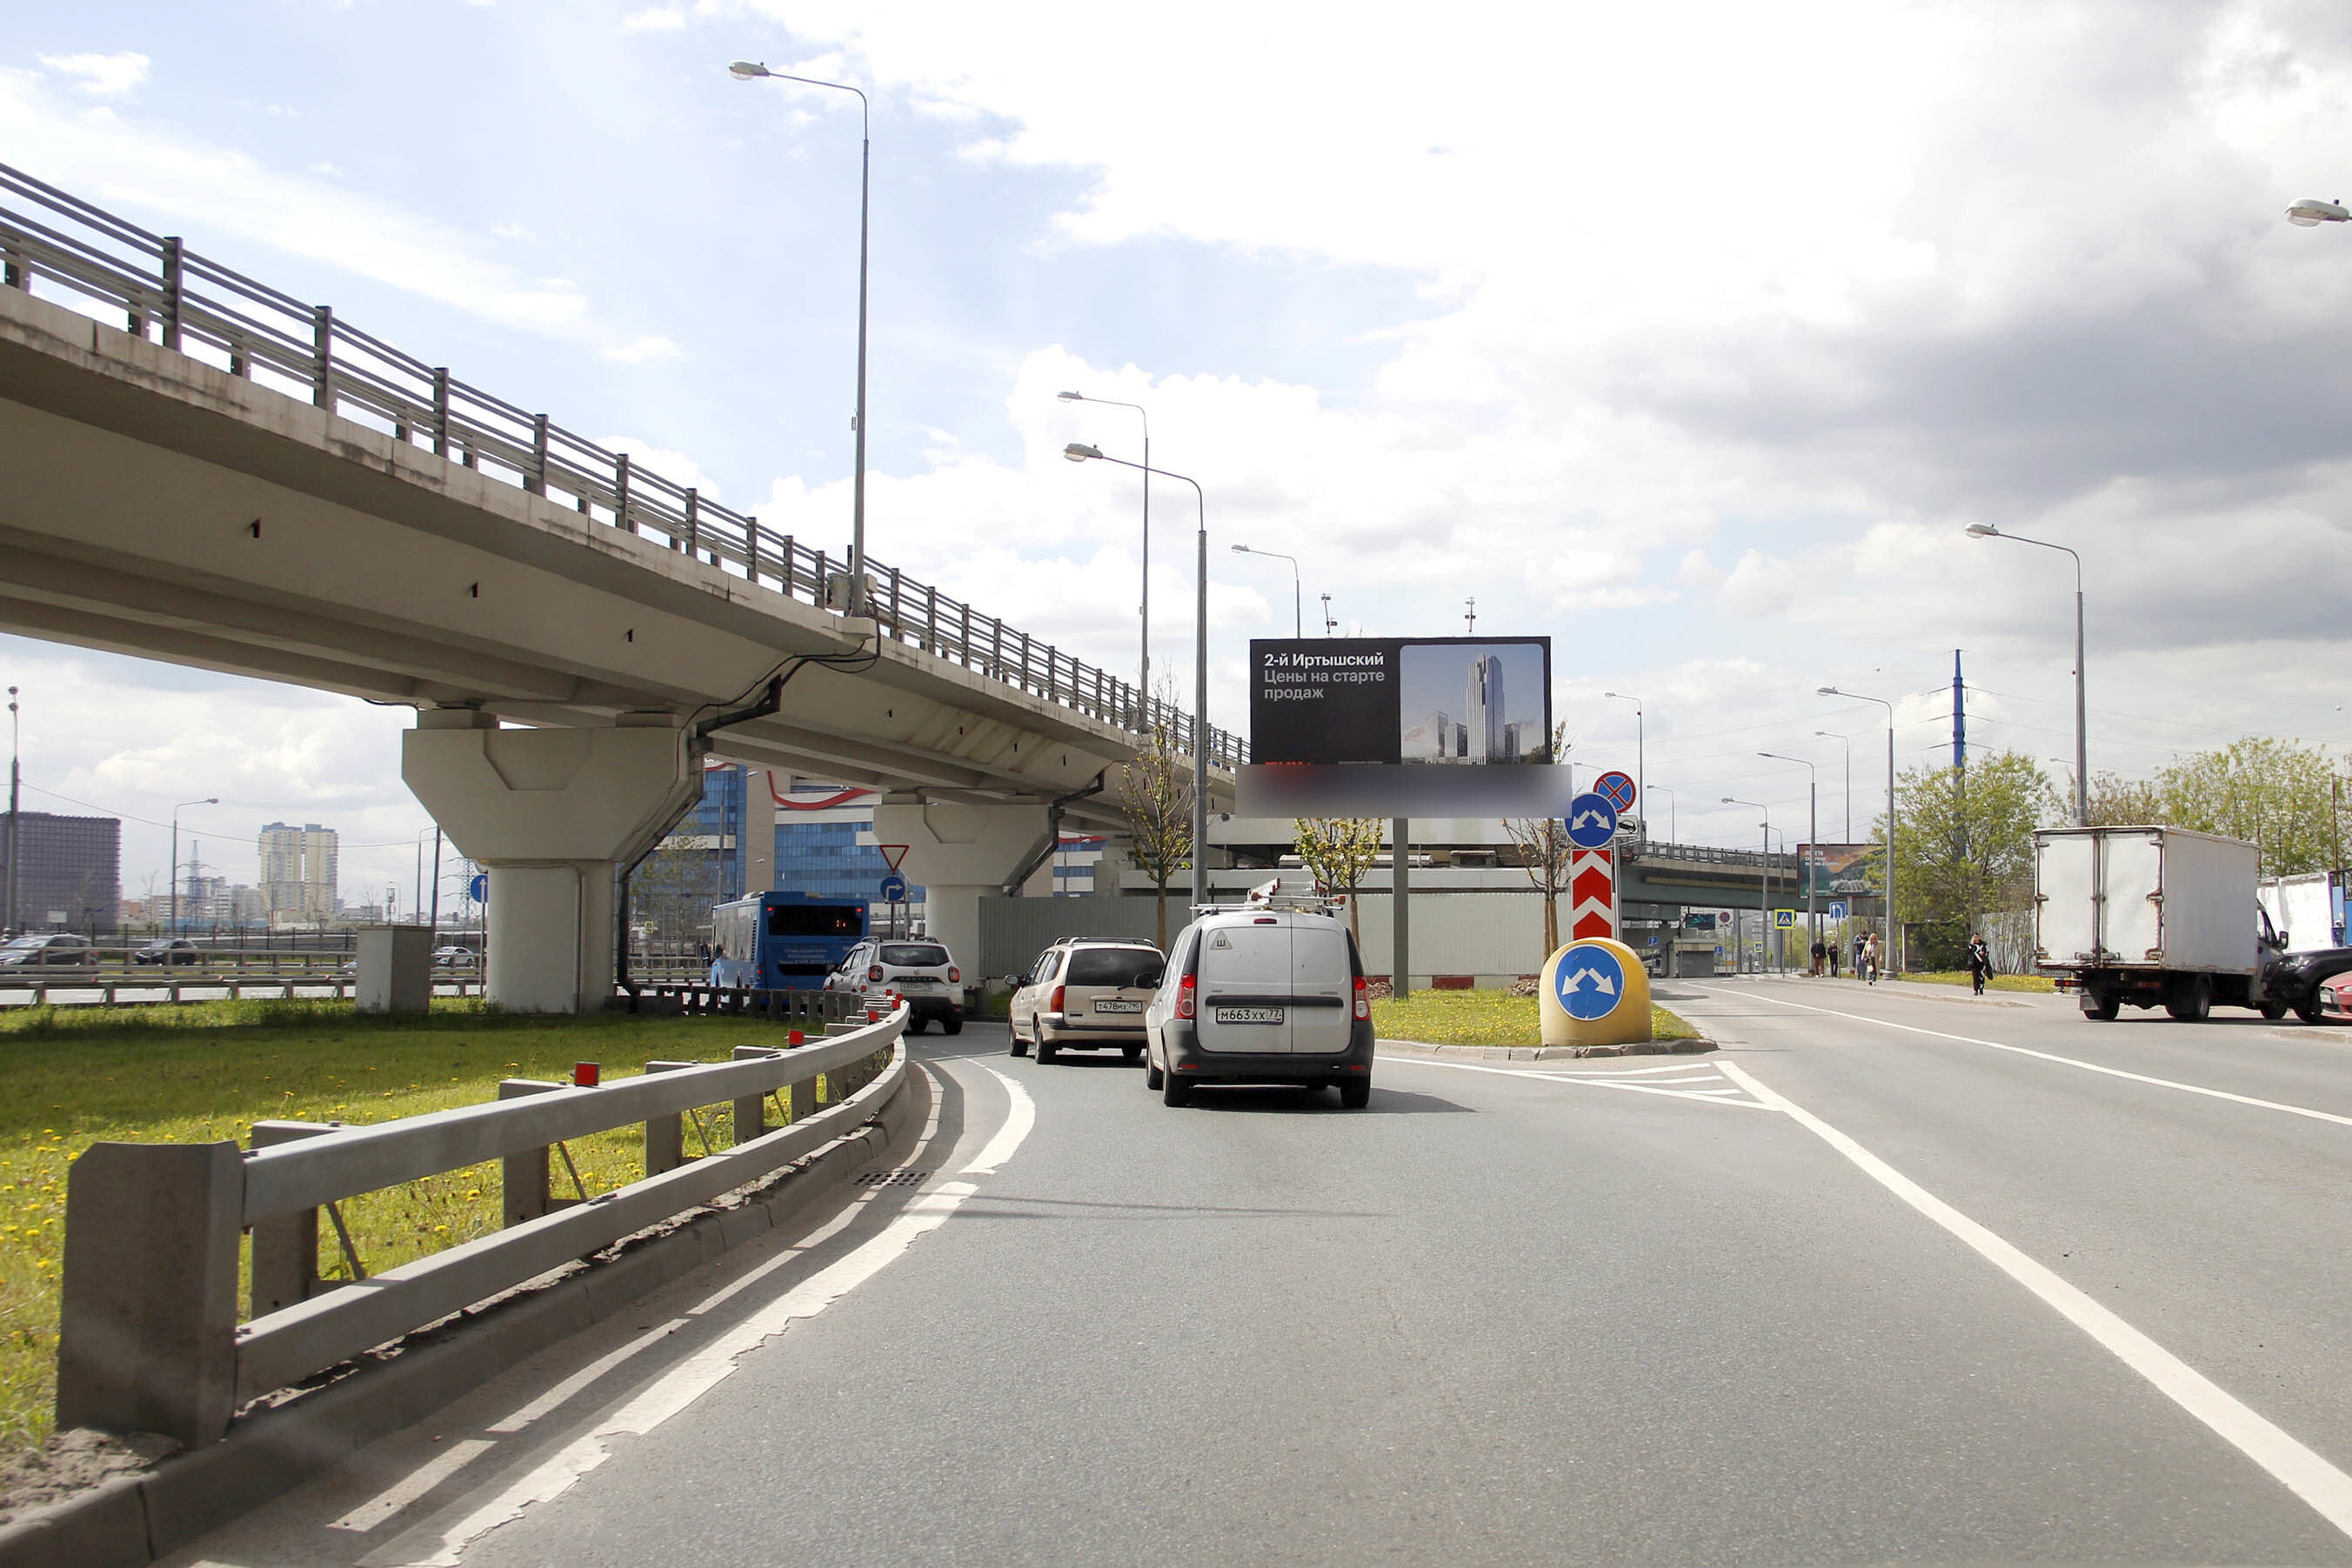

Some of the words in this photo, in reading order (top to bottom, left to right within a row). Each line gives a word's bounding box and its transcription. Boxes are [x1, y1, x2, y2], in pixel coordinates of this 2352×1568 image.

[1264, 652, 1289, 667] 2-й
[1293, 651, 1385, 669] Иртышский
[1264, 670, 1307, 684] Цены
[1311, 672, 1329, 683] на
[1333, 671, 1386, 684] старте
[1264, 688, 1325, 702] продаж
